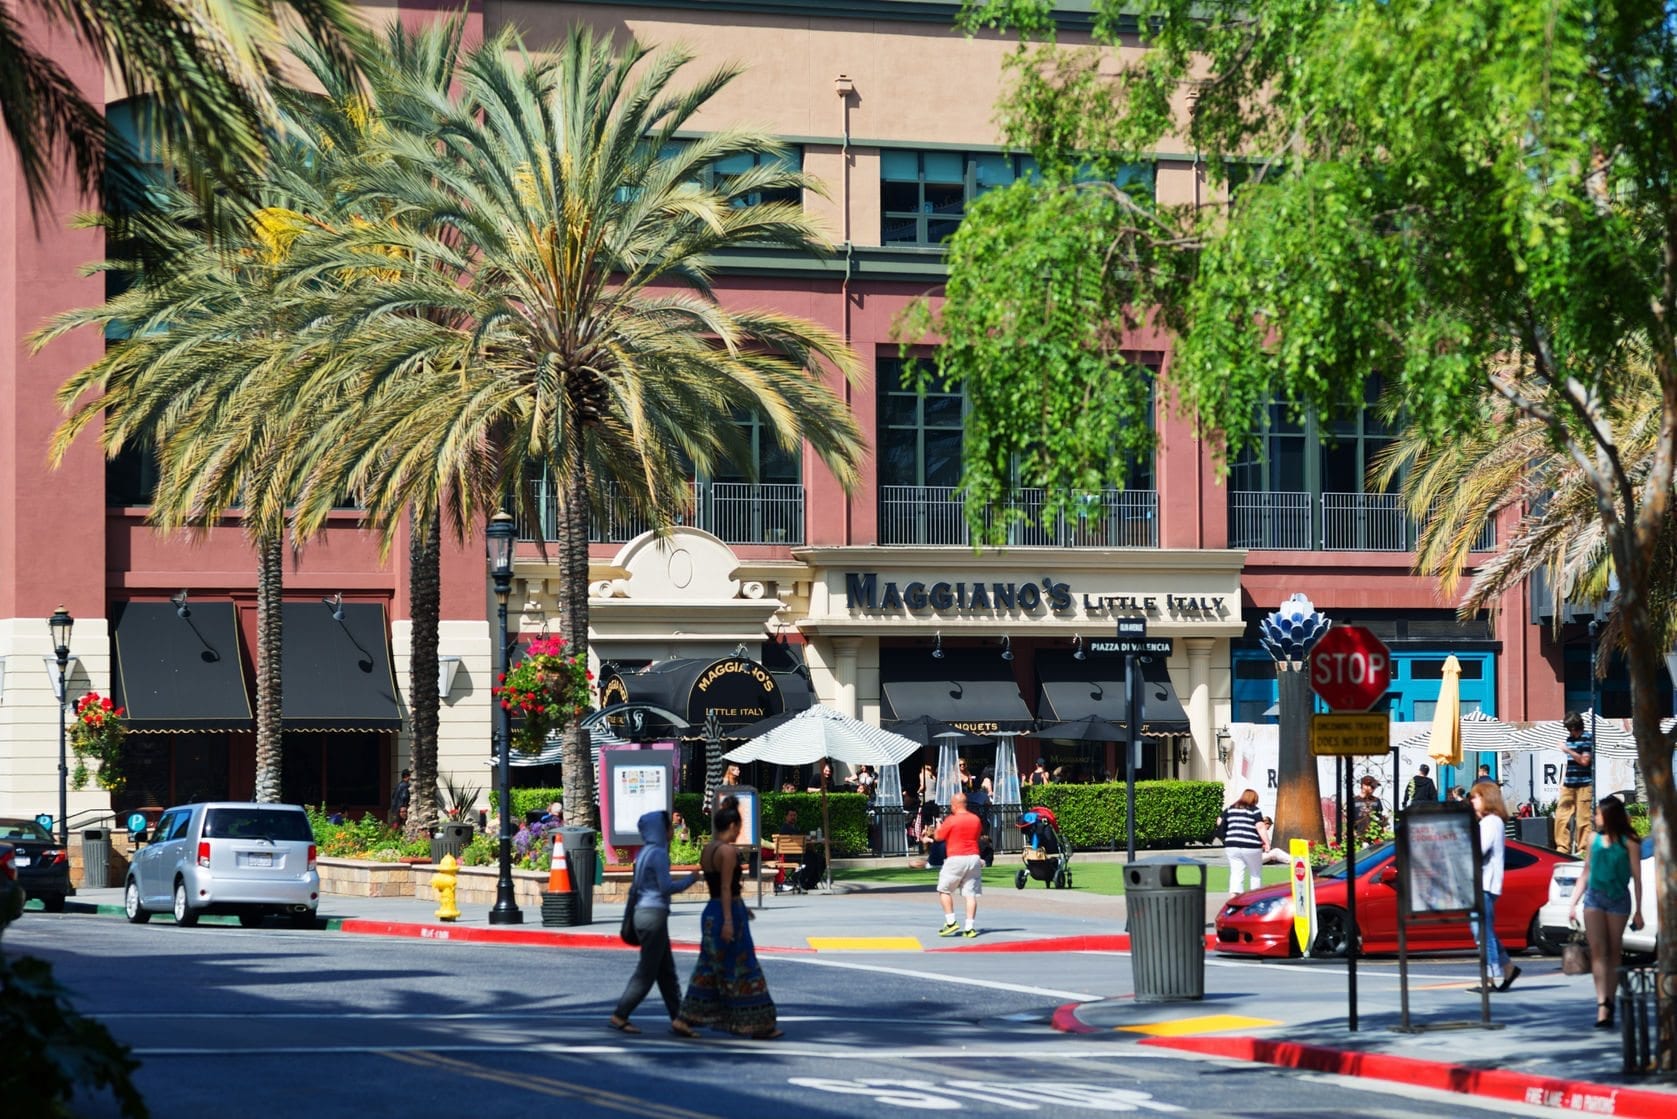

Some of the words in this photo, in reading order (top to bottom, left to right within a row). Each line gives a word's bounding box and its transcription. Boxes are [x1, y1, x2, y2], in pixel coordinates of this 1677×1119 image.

[845, 573, 1071, 610] MAGGIANO'S
[1083, 594, 1157, 610] LITTLE
[1167, 594, 1224, 610] ITALY
[1091, 643, 1119, 651] PIAZZA
[1121, 643, 1130, 651] DI
[1132, 643, 1170, 651] VALENCIA
[1315, 652, 1385, 685] STOP
[705, 707, 737, 716] LTTLE
[740, 707, 764, 716] ITALY
[954, 723, 998, 731] NQUETS
[1317, 736, 1339, 746] DOES
[1342, 736, 1359, 746] NOT
[1362, 736, 1385, 746] STOP
[132, 813, 143, 829] P
